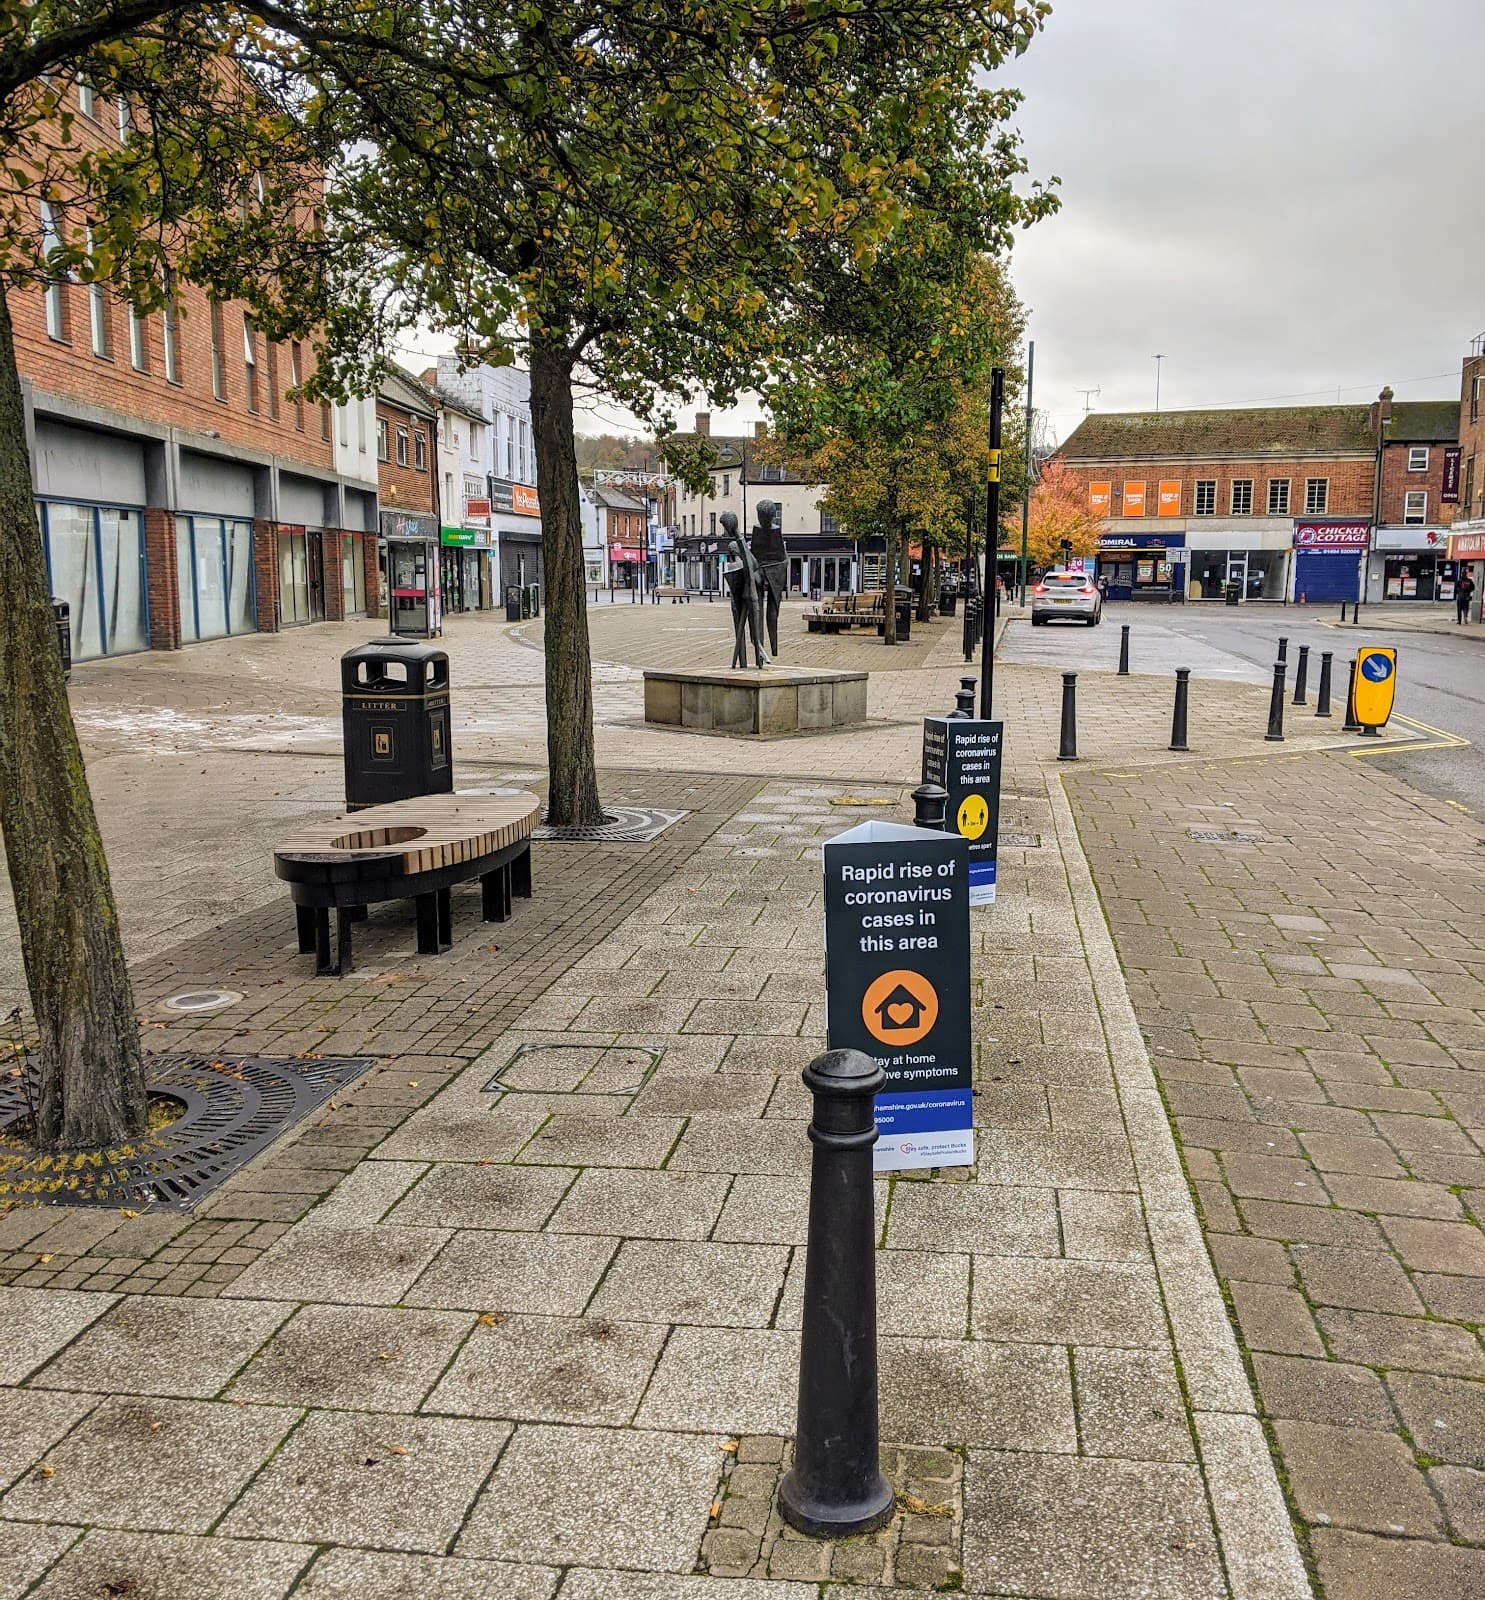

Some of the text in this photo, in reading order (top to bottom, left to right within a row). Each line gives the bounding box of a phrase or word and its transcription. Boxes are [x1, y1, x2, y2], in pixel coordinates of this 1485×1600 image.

[1317, 527, 1368, 535] CHICKEN
[1317, 534, 1367, 542] COTTAGE
[362, 702, 397, 710] LITTER
[955, 733, 999, 745] Rapid rise of
[955, 747, 997, 758] coronavirus
[961, 761, 990, 771] cases in
[960, 774, 990, 785] this area
[841, 860, 956, 884] Rapid rise of
[844, 885, 952, 905] coronavirus
[861, 909, 936, 929] cases in
[859, 934, 938, 952] this area
[871, 1053, 936, 1068] tay at home
[903, 1068, 958, 1080] symptoms
